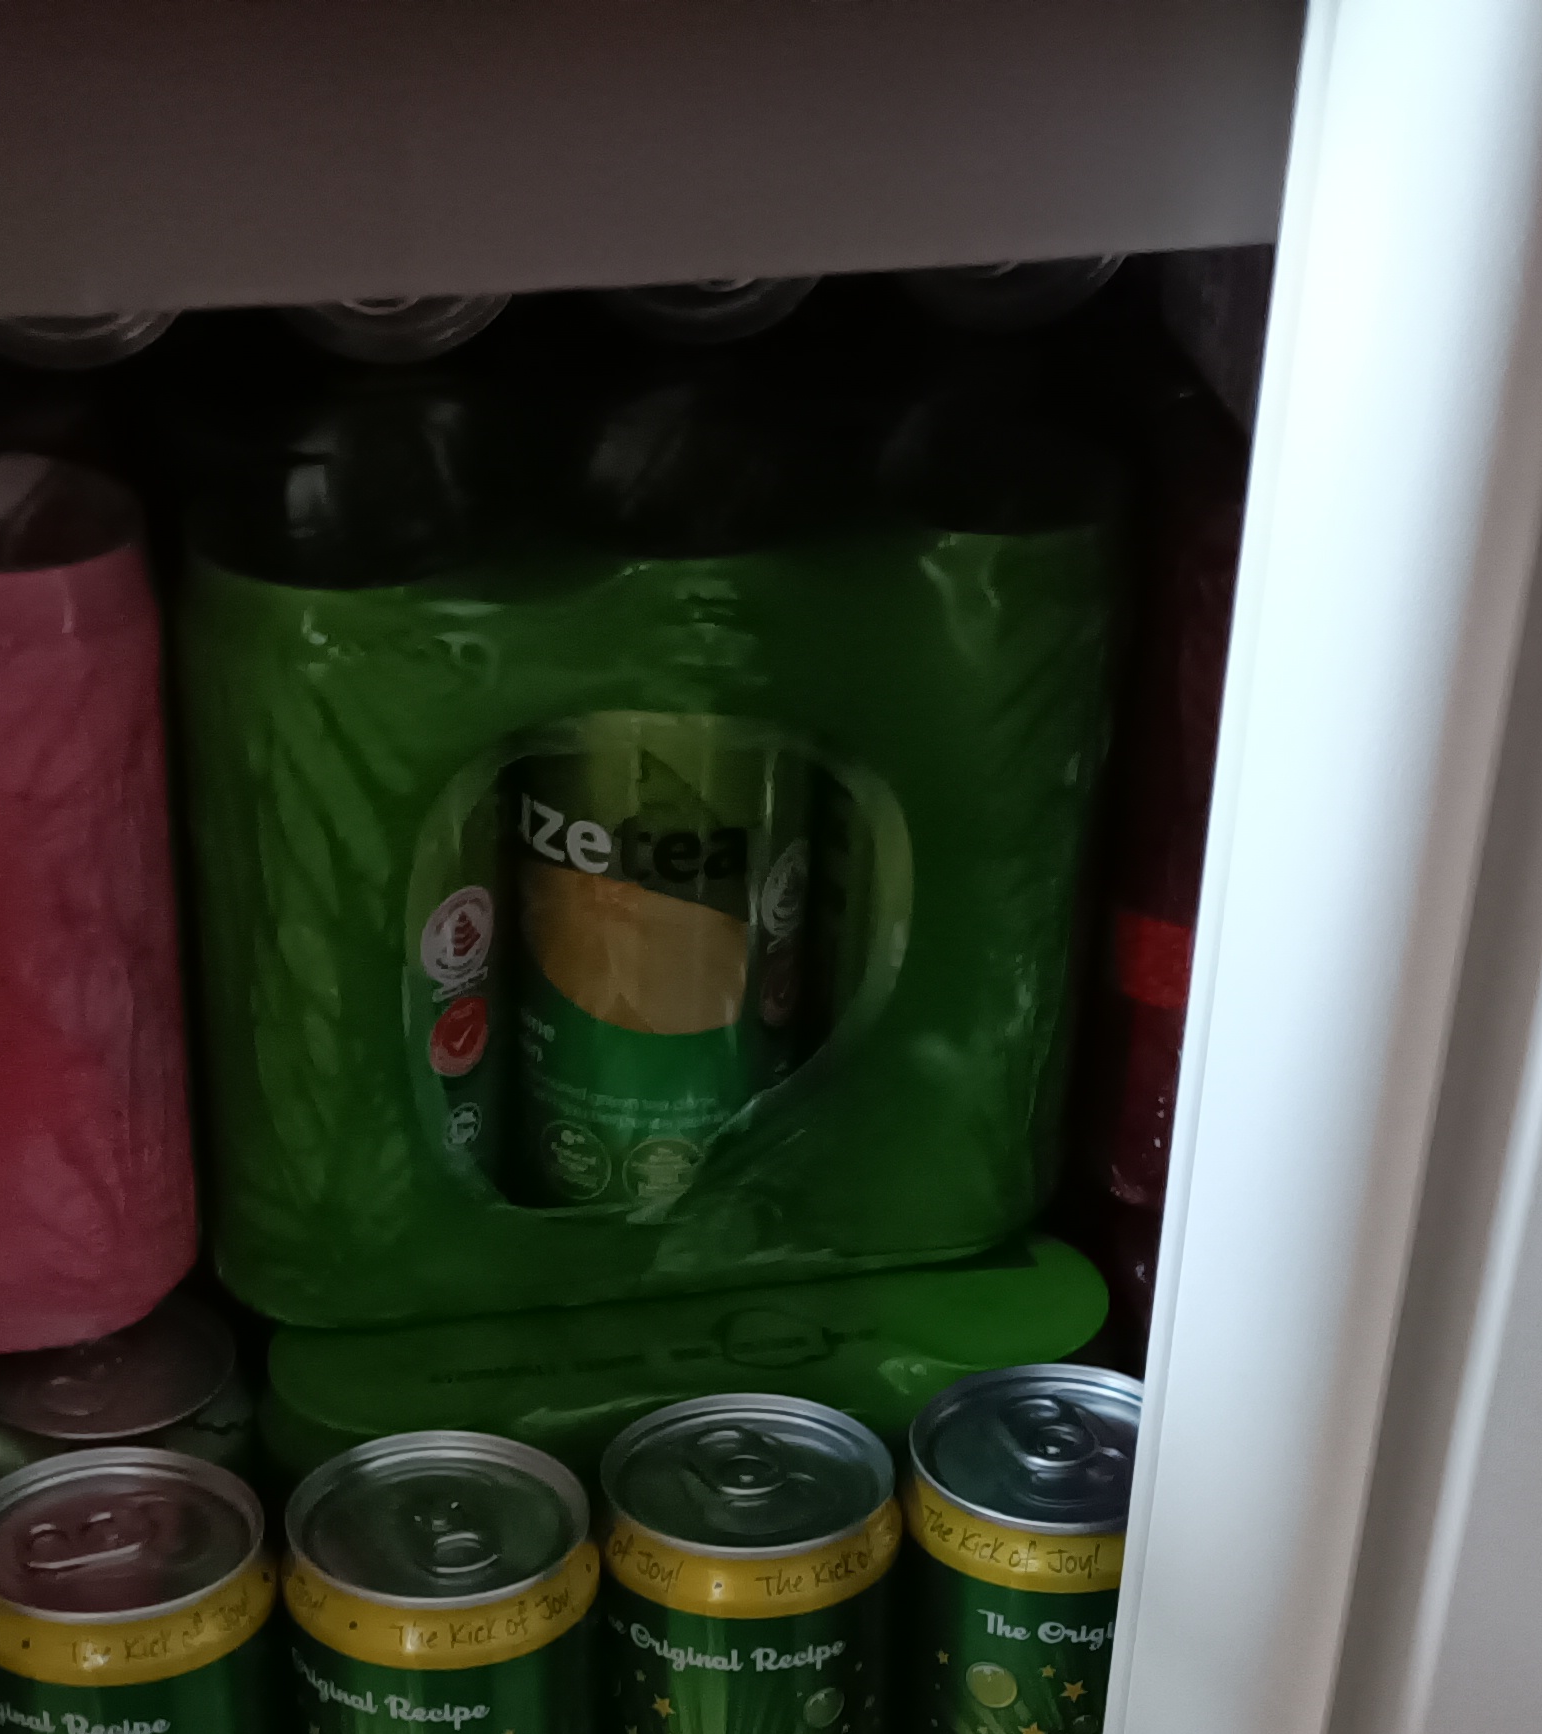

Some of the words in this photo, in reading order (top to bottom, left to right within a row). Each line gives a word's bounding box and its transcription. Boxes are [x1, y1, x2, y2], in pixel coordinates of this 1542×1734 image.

[925, 1504, 953, 1543] The
[959, 1528, 1004, 1564] Kick
[1009, 1540, 1037, 1572] of
[1048, 1543, 1101, 1579] Joy!
[755, 1569, 803, 1597] The
[629, 1622, 744, 1673] Original
[750, 1639, 846, 1673] Recipe
[976, 1608, 1031, 1641] The
[1037, 1621, 1114, 1651] Origi
[385, 1694, 490, 1731] Recipe
